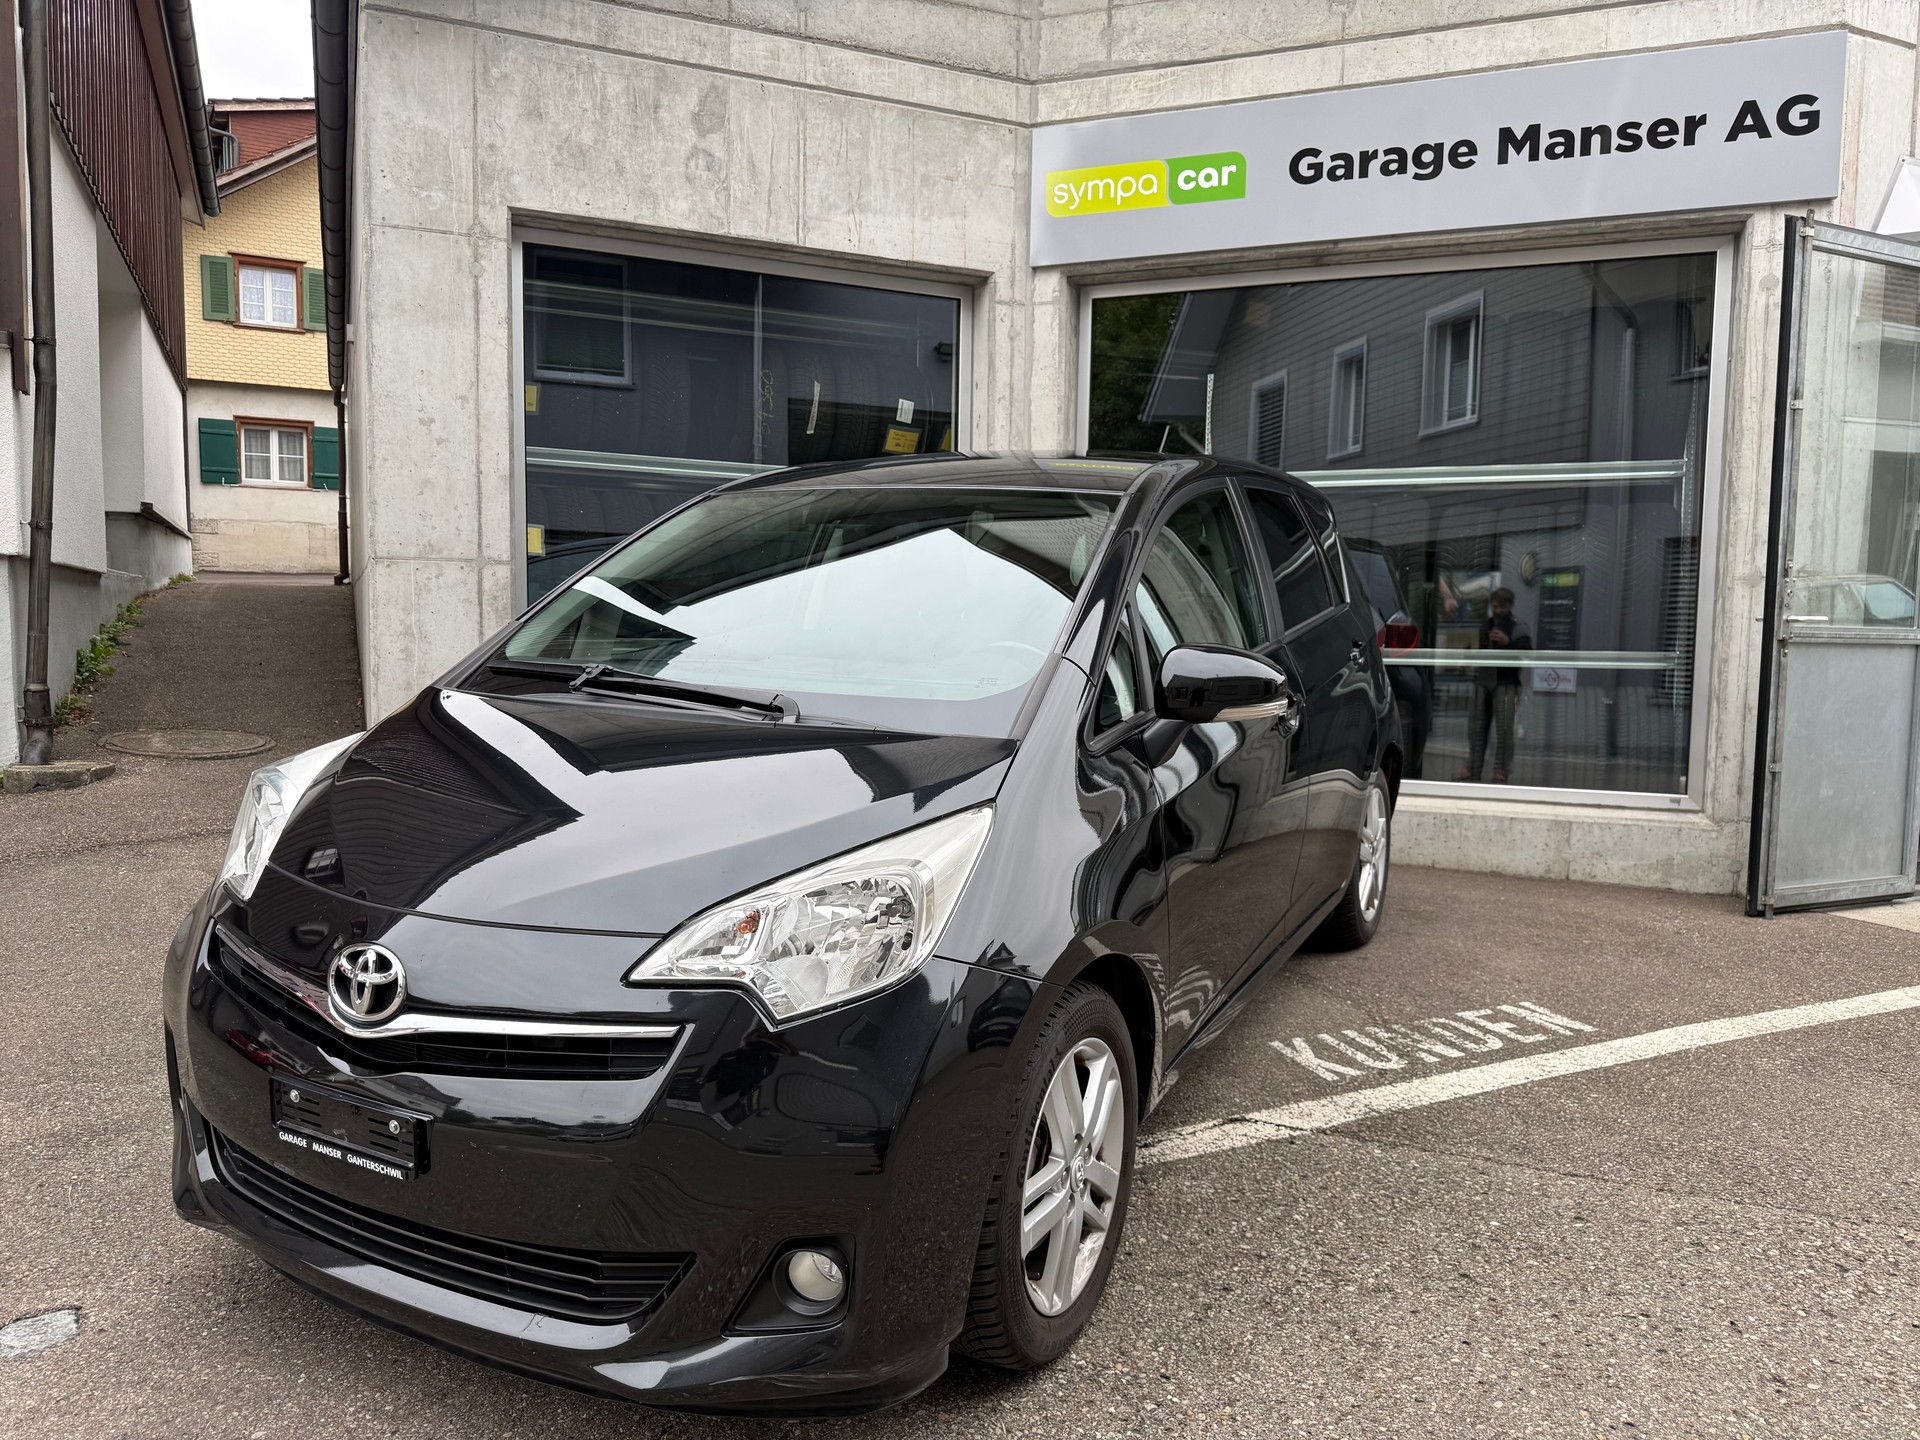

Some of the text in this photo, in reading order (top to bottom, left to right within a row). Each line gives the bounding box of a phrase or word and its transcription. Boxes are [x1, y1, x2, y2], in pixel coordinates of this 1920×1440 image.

[1288, 93, 1822, 185] Garage Manser AG
[1053, 164, 1237, 210] sympa car
[1267, 1001, 1599, 1082] KUNDEN
[278, 1131, 404, 1180] GARAGE MANSER GANTERSCHWIL
